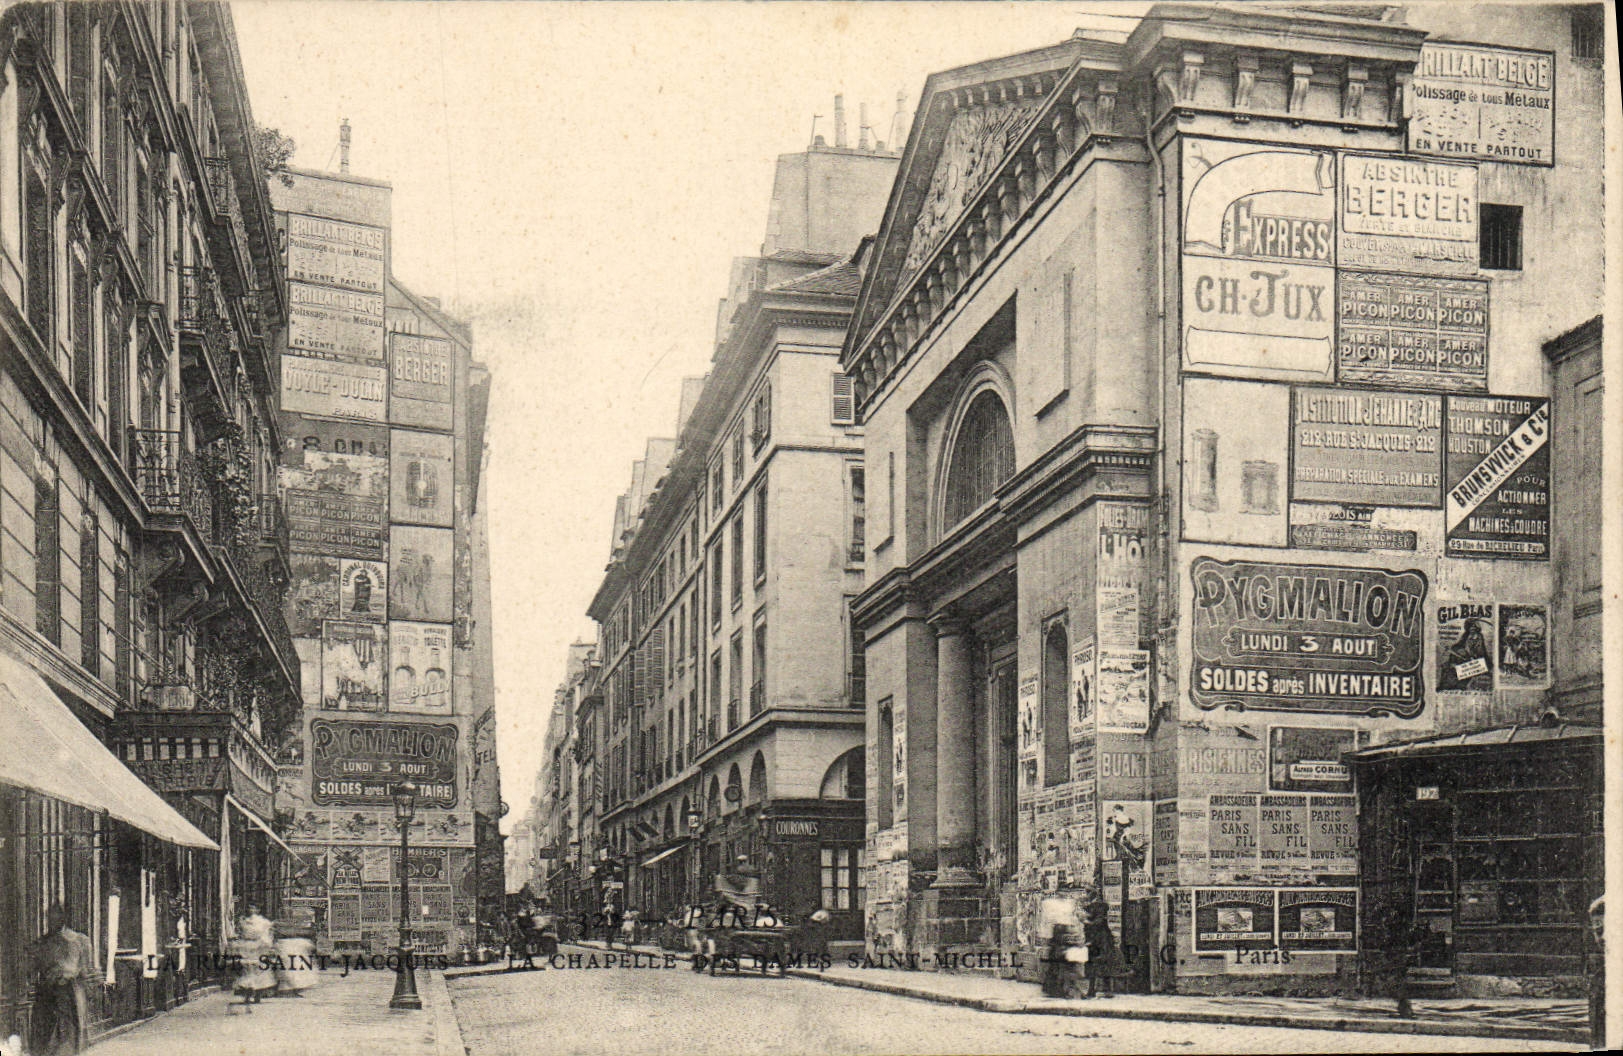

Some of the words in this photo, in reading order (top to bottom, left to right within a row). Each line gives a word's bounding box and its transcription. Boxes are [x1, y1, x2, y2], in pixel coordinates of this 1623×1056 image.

[1420, 50, 1491, 79] RILLANT
[1496, 56, 1551, 88] BELGE
[1482, 93, 1503, 105] tous
[1416, 139, 1431, 149] EN
[1438, 141, 1477, 153] VENTE
[1487, 144, 1542, 158] PARTOUT
[1362, 162, 1459, 188] ABSINTHE
[1345, 183, 1473, 224] BERGER
[1233, 199, 1330, 261] EXPRESS
[309, 273, 335, 282] VENTE
[340, 278, 377, 289] PARTOUT
[1350, 291, 1382, 302] AMER
[1399, 295, 1429, 306] AMER
[1343, 301, 1388, 318] PICON
[1446, 298, 1478, 309] AMER
[1391, 304, 1435, 321] PICON
[1439, 308, 1483, 325] PICON
[294, 338, 305, 346] EN
[309, 340, 335, 350] VENTE
[1350, 333, 1381, 345] AMER
[1398, 336, 1429, 348] AMER
[1445, 339, 1476, 351] AMER
[1342, 344, 1387, 360] PICON
[1390, 348, 1435, 363] PICON
[1438, 351, 1483, 366] PICON
[1487, 399, 1531, 415] MOTEUR
[1448, 416, 1510, 436] THOMSON
[1324, 430, 1347, 449] RUE
[1448, 437, 1491, 454] HOUSTON
[1451, 437, 1524, 509] BRUNSWICK
[1520, 432, 1533, 446] &
[1516, 474, 1547, 487] POUR
[1497, 490, 1547, 505] ACTIONNER
[321, 510, 350, 520] PICON
[351, 512, 380, 522] PICON
[1468, 516, 1510, 533] MACHINES
[1514, 519, 1547, 536] COUDRE
[290, 530, 319, 540] PICON
[321, 533, 350, 543] PICON
[351, 537, 380, 547] PICON
[1197, 569, 1420, 638] PYGMALION
[1437, 606, 1459, 624] GIL
[1460, 603, 1492, 619] BLAS
[1240, 634, 1288, 652] LUNDI
[1300, 635, 1320, 653] 3
[1332, 638, 1375, 656] AOUT
[1200, 667, 1270, 693] SOLDES
[1272, 676, 1304, 696] après
[1308, 673, 1413, 697] INVENTAIRE
[314, 725, 456, 762] PYGMALION
[343, 762, 373, 772] LUNDI
[400, 764, 427, 774] AOUT
[1315, 766, 1348, 774] CORNU
[319, 782, 362, 795] SOLDES
[1211, 809, 1242, 821] PARIS
[1262, 810, 1292, 821] PARIS
[1311, 810, 1341, 821] PARIS
[775, 820, 819, 836] COURONNES
[1222, 823, 1249, 834] SANS
[1272, 823, 1300, 834] SANS
[1321, 823, 1349, 834] SANS
[1235, 836, 1256, 847] FIL
[1286, 836, 1307, 847] FIL
[1336, 836, 1356, 847] FIL
